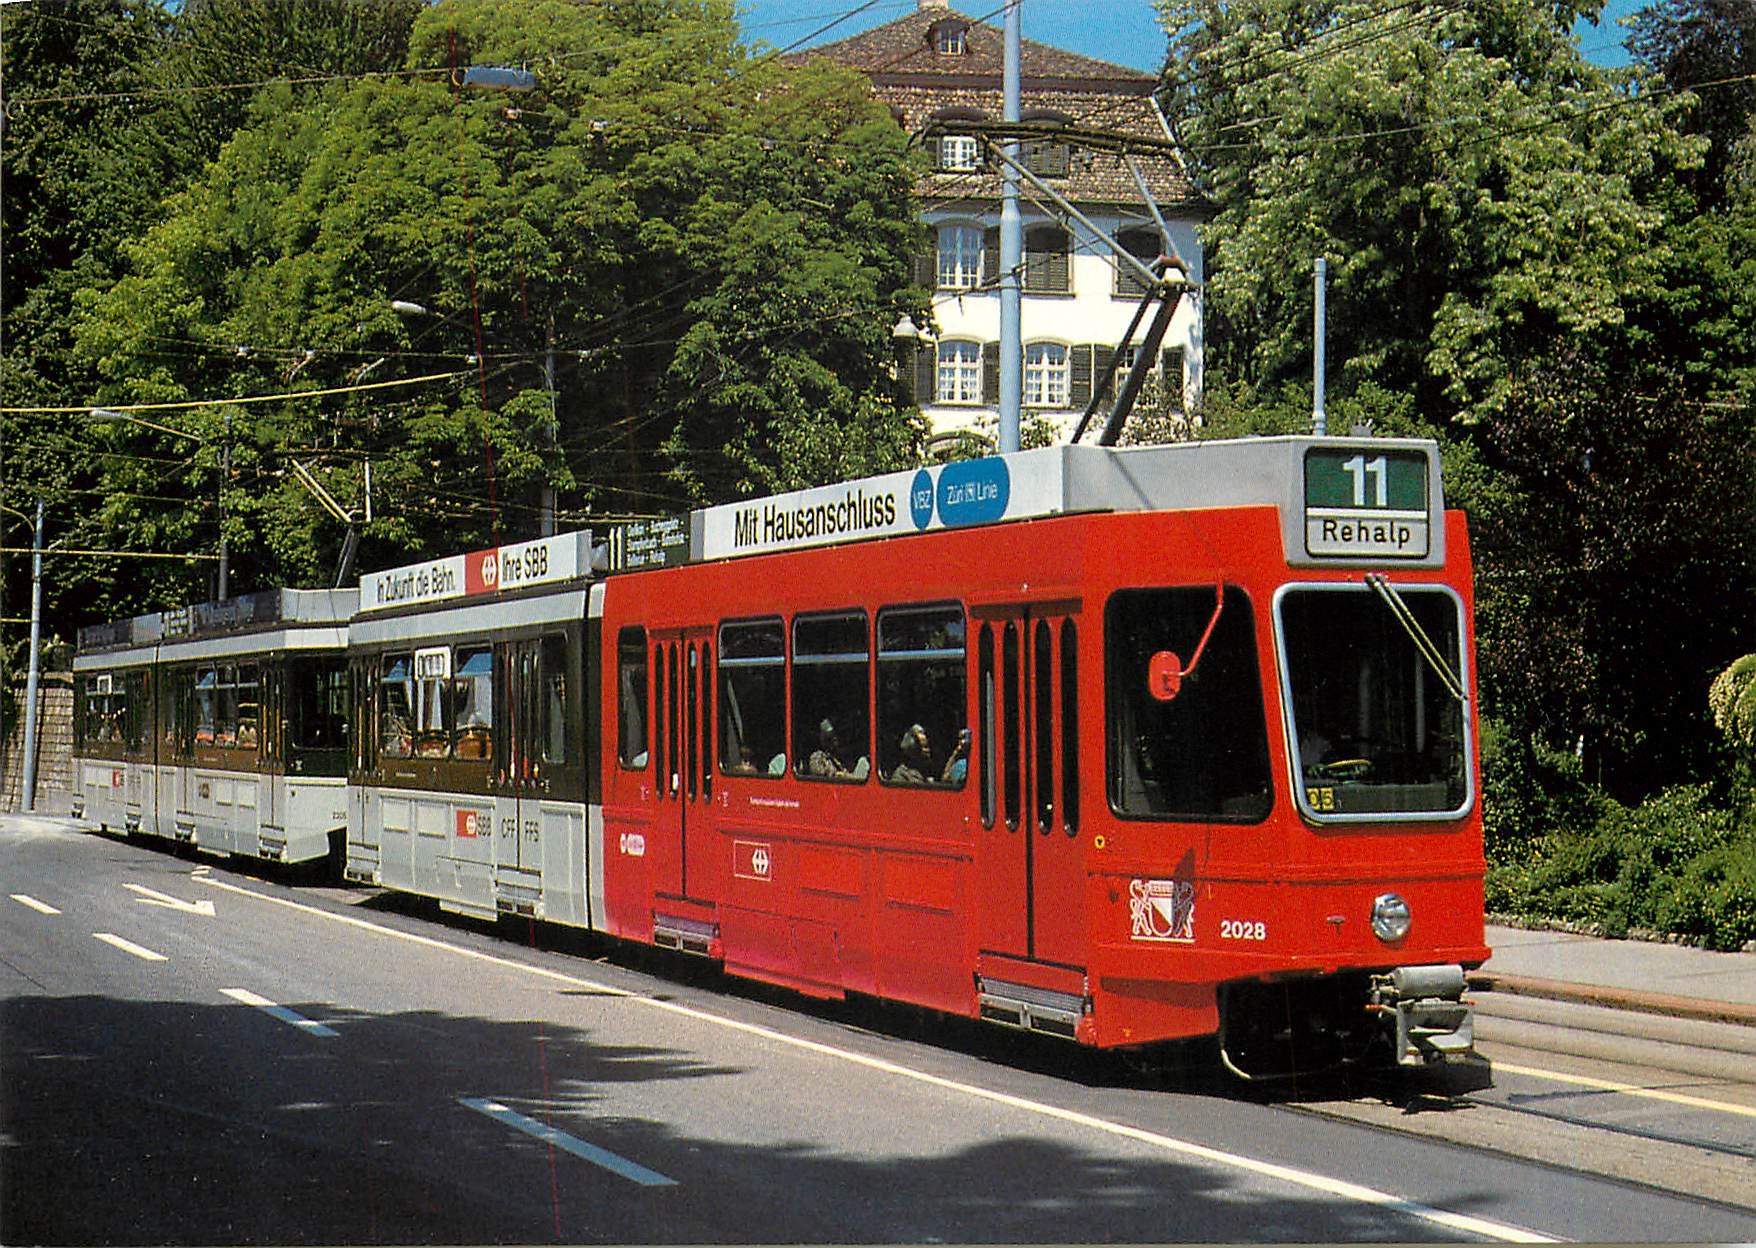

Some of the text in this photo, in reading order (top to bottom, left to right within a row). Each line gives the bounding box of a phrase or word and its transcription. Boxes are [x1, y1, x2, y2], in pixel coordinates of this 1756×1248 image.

[1343, 455, 1387, 506] 11
[735, 508, 758, 547] Mit
[764, 490, 895, 542] Hausanschluss
[1322, 519, 1410, 549] Rehalp
[503, 545, 548, 583] Ihre SBB
[386, 572, 415, 601] Zukunft
[416, 571, 429, 596] die
[1220, 920, 1266, 940] 2028
